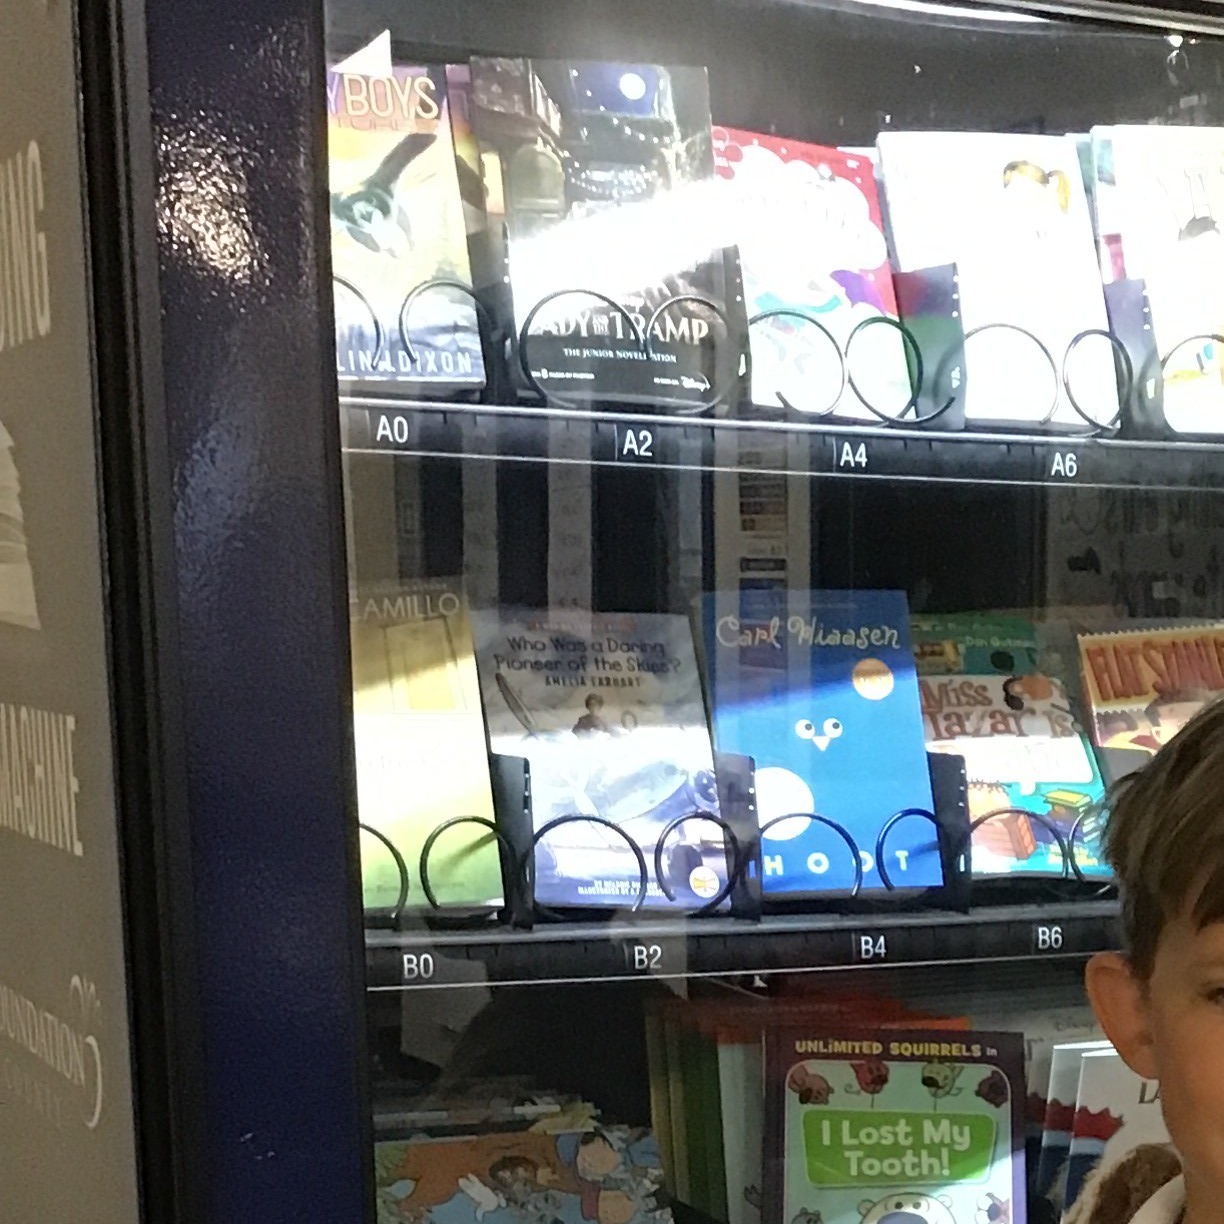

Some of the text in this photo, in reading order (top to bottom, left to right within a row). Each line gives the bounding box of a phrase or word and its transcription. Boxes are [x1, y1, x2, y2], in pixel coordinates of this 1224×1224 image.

[563, 348, 677, 363] THE JUNIOR NOVELIATION
[376, 415, 409, 443] A0
[622, 429, 653, 457] A2
[840, 442, 868, 468] A4
[1051, 453, 1078, 477] A6
[716, 616, 781, 649] Carl
[507, 636, 546, 651] Who
[550, 638, 587, 651] Was
[607, 638, 667, 658] Daring
[568, 656, 588, 672] of
[595, 657, 622, 672] the
[860, 936, 887, 958] B4
[1037, 926, 1062, 949] B6
[403, 954, 434, 979] B0
[633, 945, 662, 970] B2
[890, 1042, 981, 1057] SQUIRRELS
[822, 1119, 971, 1153] I Lost My
[844, 1149, 951, 1177] Tooth!
